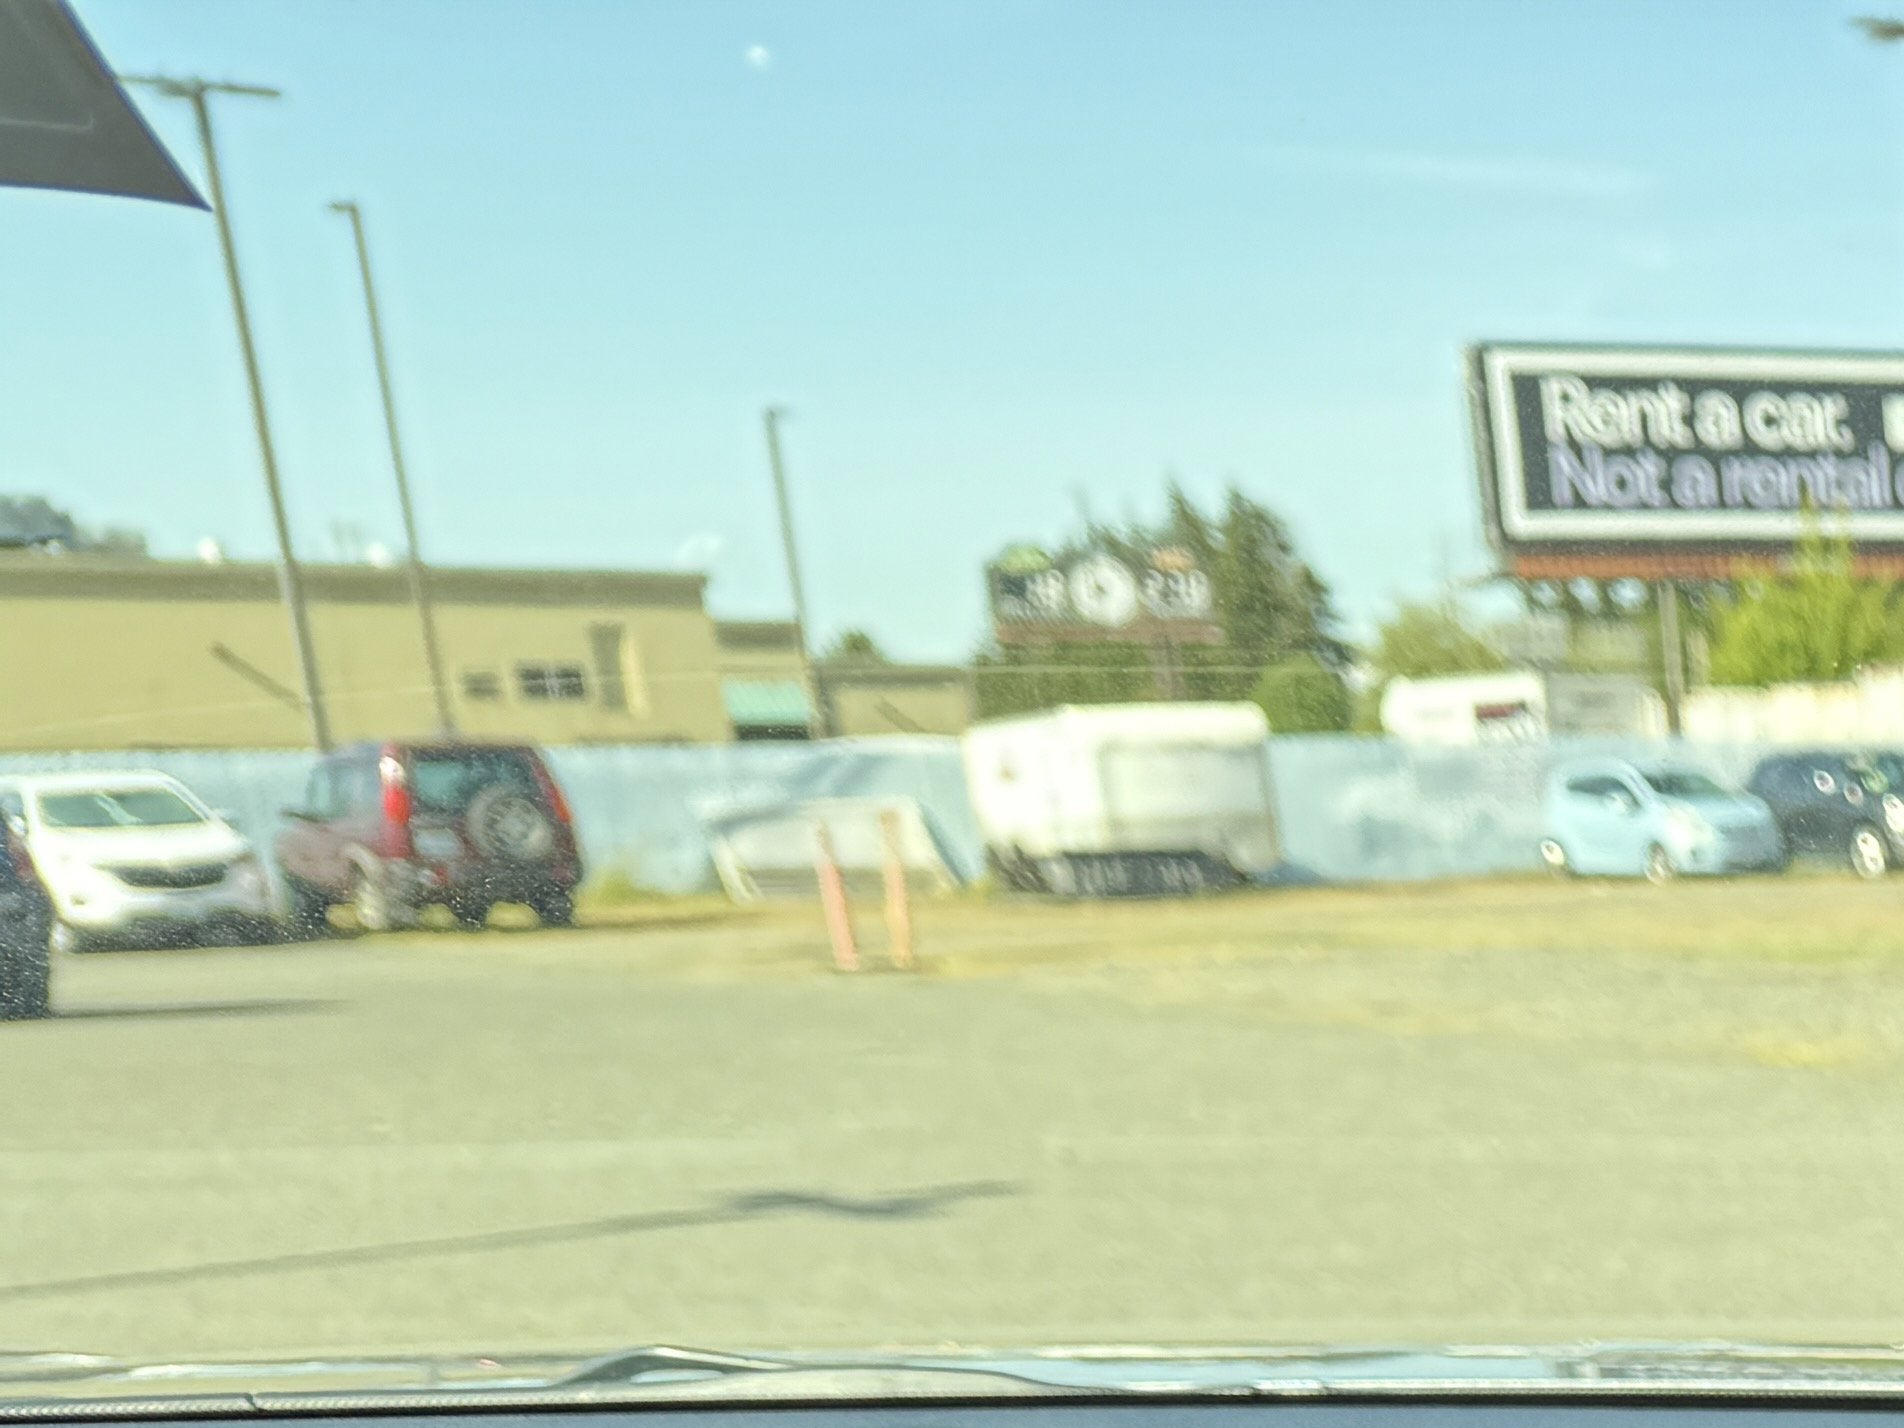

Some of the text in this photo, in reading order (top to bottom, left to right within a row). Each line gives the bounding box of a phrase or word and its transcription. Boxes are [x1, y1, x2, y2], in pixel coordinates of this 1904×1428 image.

[1539, 373, 1695, 450] Rent
[1694, 389, 1744, 450] a
[1547, 441, 1672, 509] Not
[1671, 453, 1721, 509] a
[1720, 440, 1892, 510] rental
